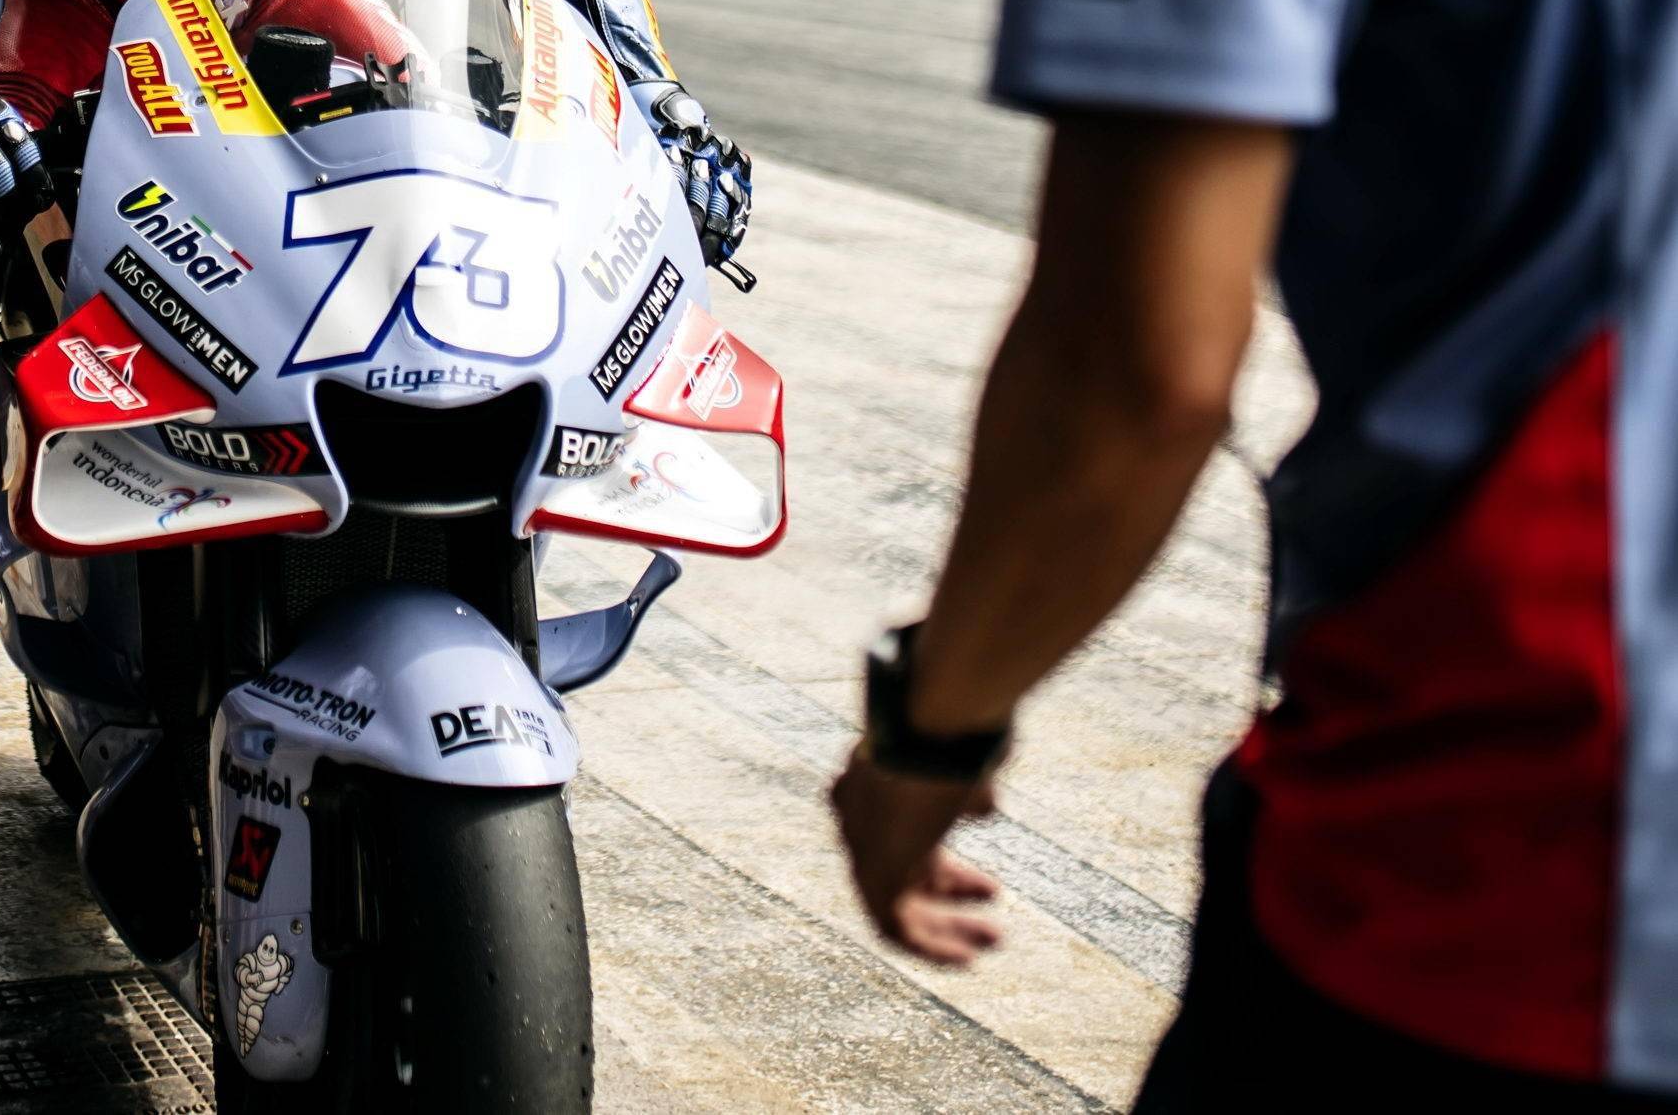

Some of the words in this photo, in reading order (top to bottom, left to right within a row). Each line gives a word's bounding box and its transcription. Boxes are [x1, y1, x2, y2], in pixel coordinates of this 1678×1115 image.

[122, 40, 196, 133] YOU-ALL
[116, 179, 245, 293] Unibat
[581, 191, 664, 305] Unibat
[277, 167, 566, 379] 73
[114, 250, 145, 287] MS
[140, 280, 198, 335] GLOW
[196, 332, 249, 385] MEN
[69, 341, 119, 391] FEDERAL
[365, 364, 503, 394] Gigetta
[592, 355, 622, 394] MS
[615, 305, 655, 366] GLOW
[91, 440, 163, 489] wonderful
[163, 423, 251, 463] BOLD
[73, 451, 166, 508] indonesia
[250, 671, 376, 730] MOTO-TRON
[294, 708, 362, 742] RACING
